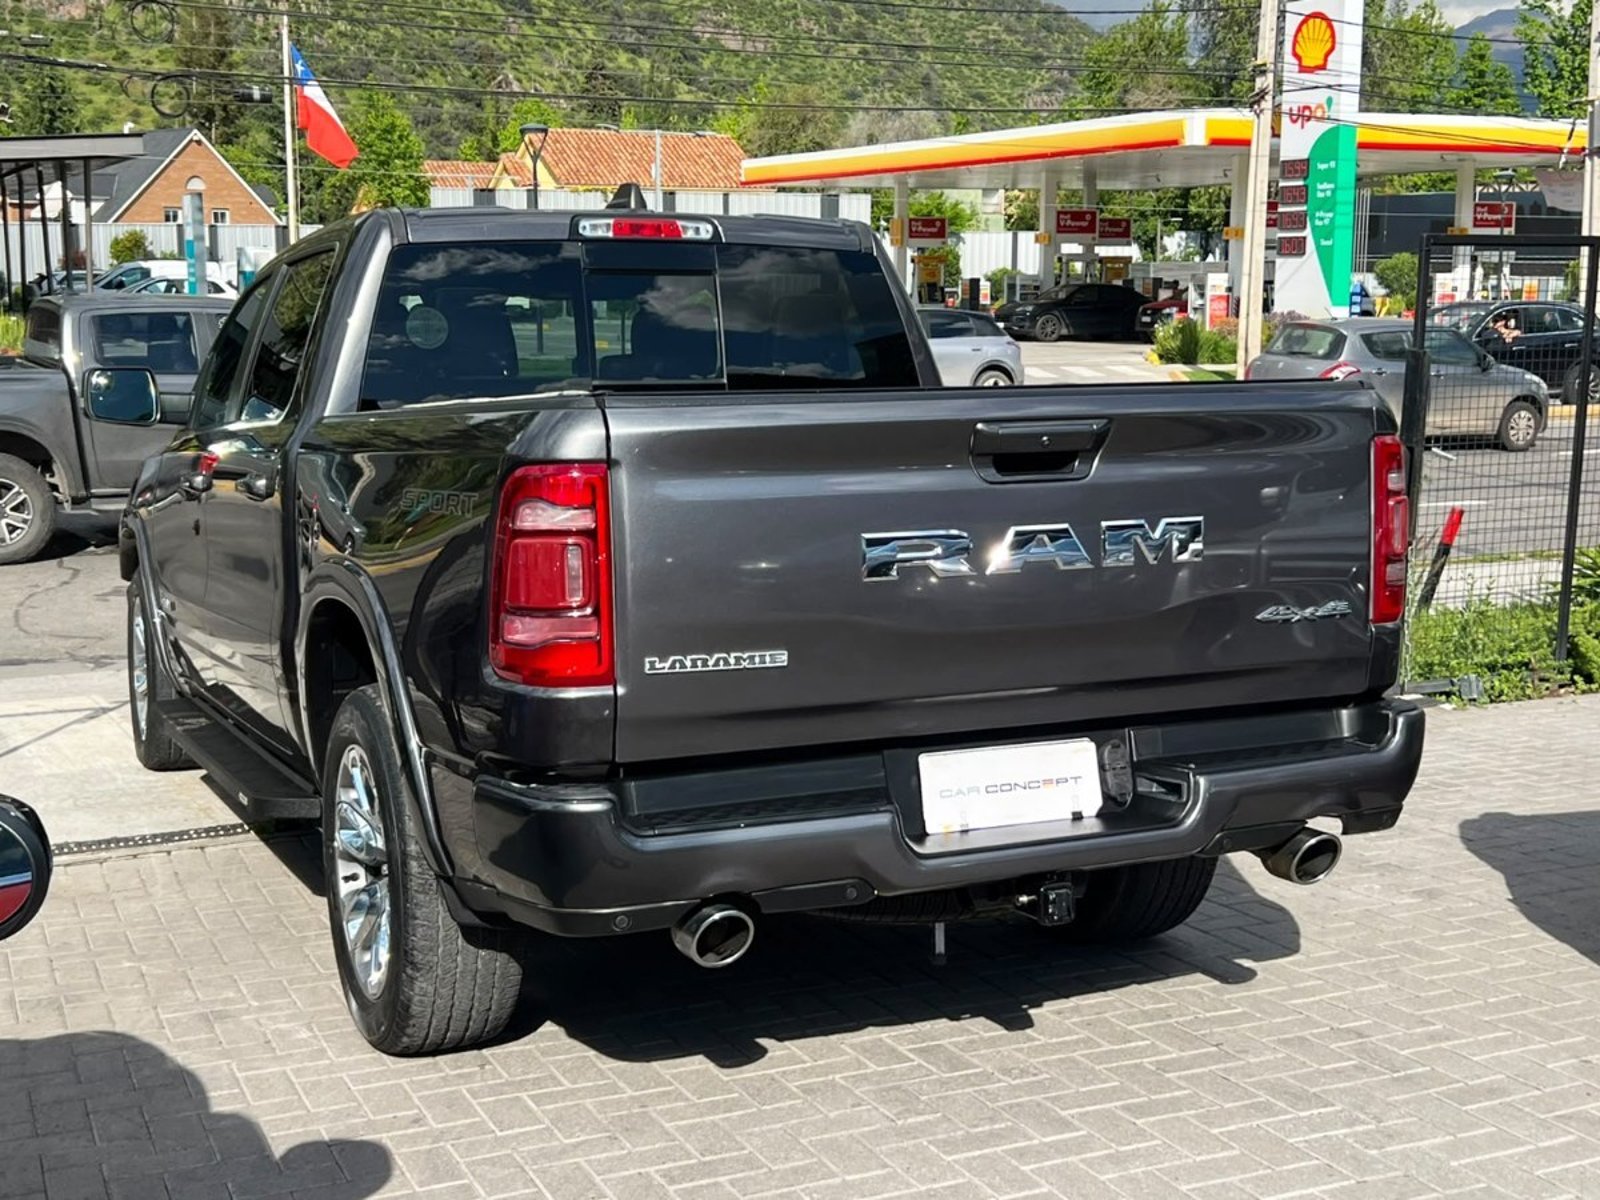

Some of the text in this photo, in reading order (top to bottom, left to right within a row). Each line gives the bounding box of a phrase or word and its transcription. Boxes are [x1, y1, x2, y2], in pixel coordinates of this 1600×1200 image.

[400, 488, 479, 518] SPORT
[861, 515, 1205, 583] RAM
[644, 650, 789, 674] LARAMIE
[939, 775, 1083, 799] CAR CONCEPT
